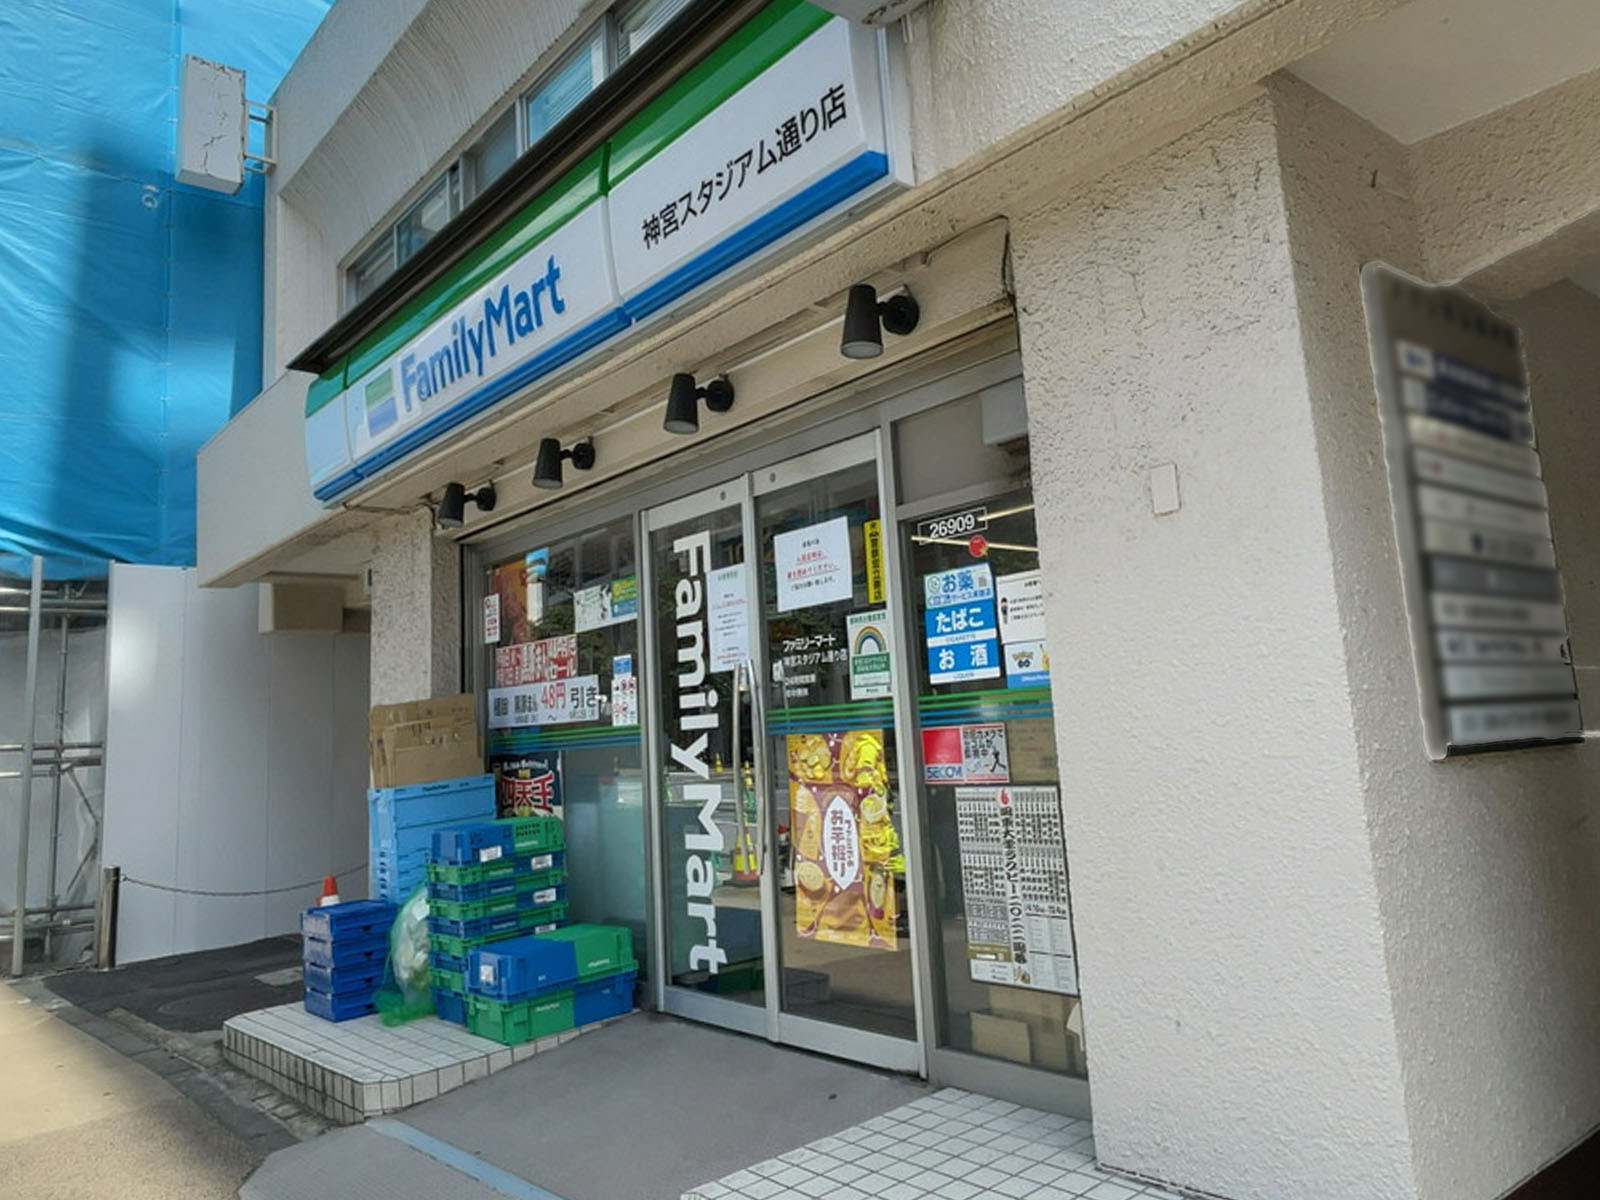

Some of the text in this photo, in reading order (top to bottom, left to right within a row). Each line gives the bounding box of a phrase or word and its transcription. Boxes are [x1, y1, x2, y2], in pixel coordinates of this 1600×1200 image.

[641, 83, 848, 249] 神宮スタジアム通り店
[401, 255, 566, 412] FamilyMart
[929, 513, 976, 539] 26909
[941, 568, 974, 593] お薬
[935, 607, 984, 633] たばこ
[782, 633, 837, 653] ファミリーマート
[671, 529, 728, 976] FamilyMart
[926, 766, 964, 779] SECOM
